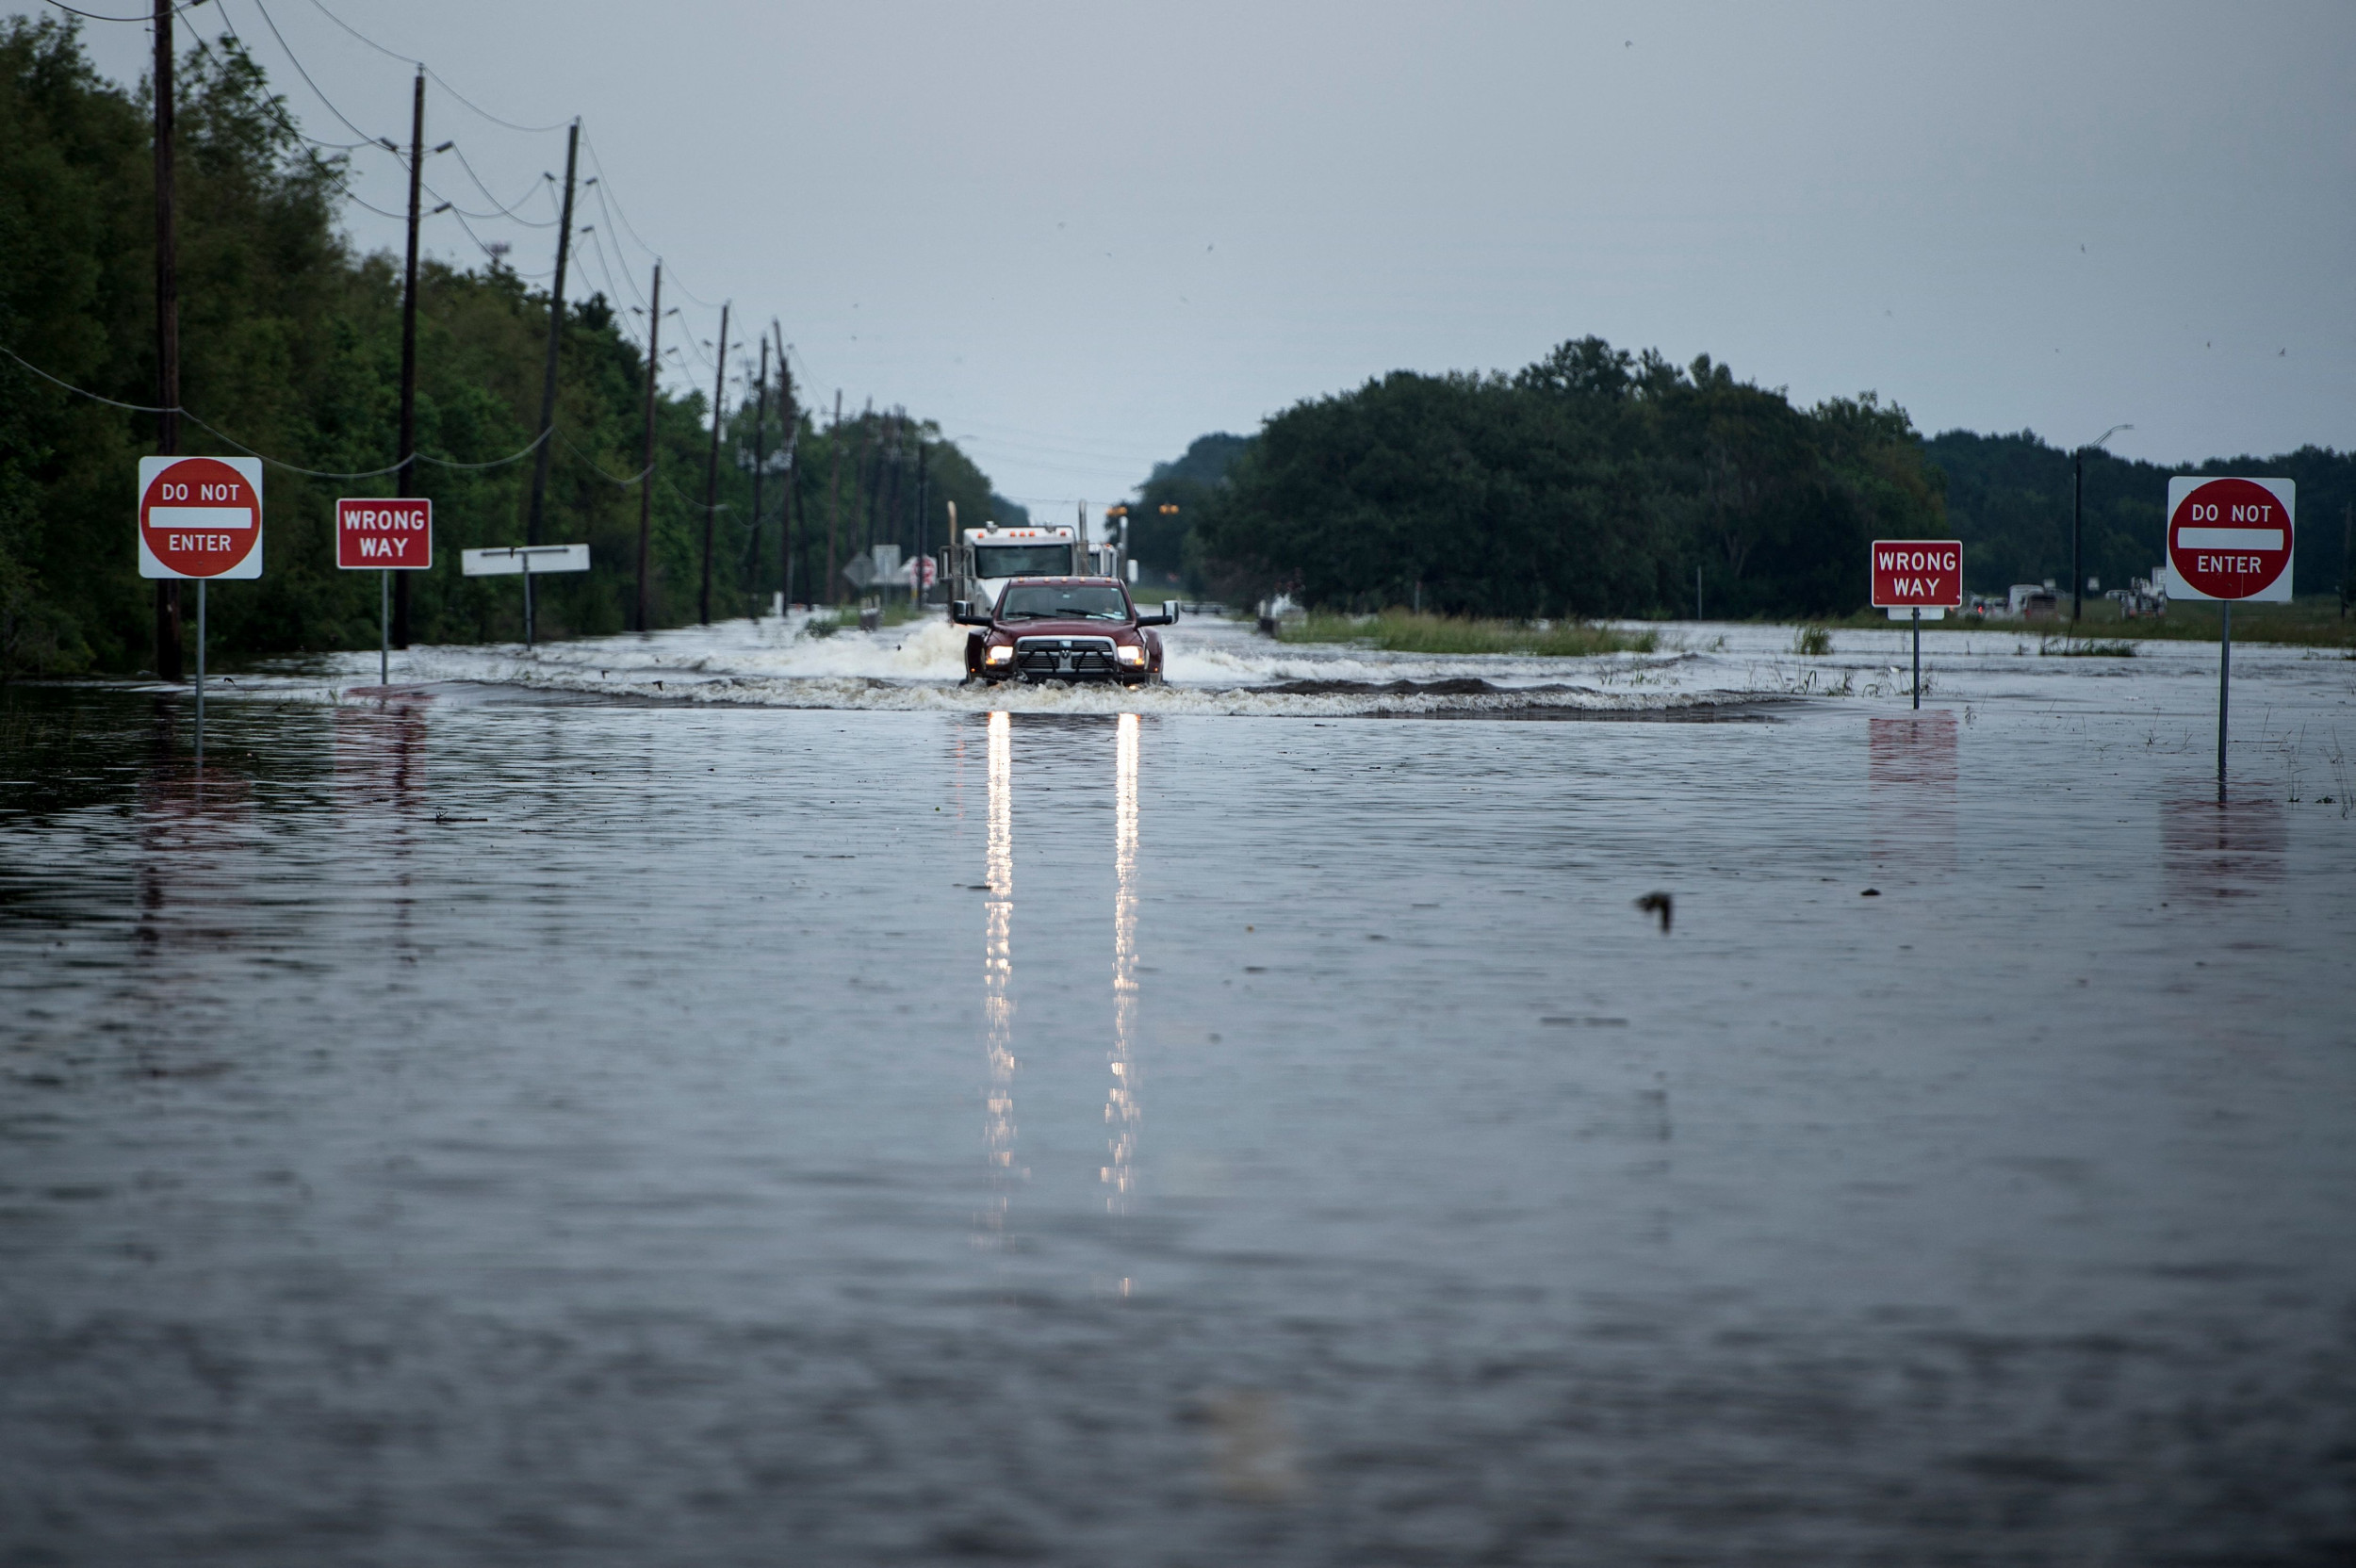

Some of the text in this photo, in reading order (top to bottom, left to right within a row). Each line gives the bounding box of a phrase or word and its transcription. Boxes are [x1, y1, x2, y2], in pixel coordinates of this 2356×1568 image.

[162, 483, 240, 501] DO NOT
[344, 510, 424, 530] WRONG
[2192, 504, 2272, 522] DO NOT
[169, 534, 231, 551] ENTER
[360, 537, 409, 557] WAY
[1879, 552, 1955, 571] WRONG
[2198, 556, 2261, 574] ENTER
[1893, 578, 1940, 596] WAY
